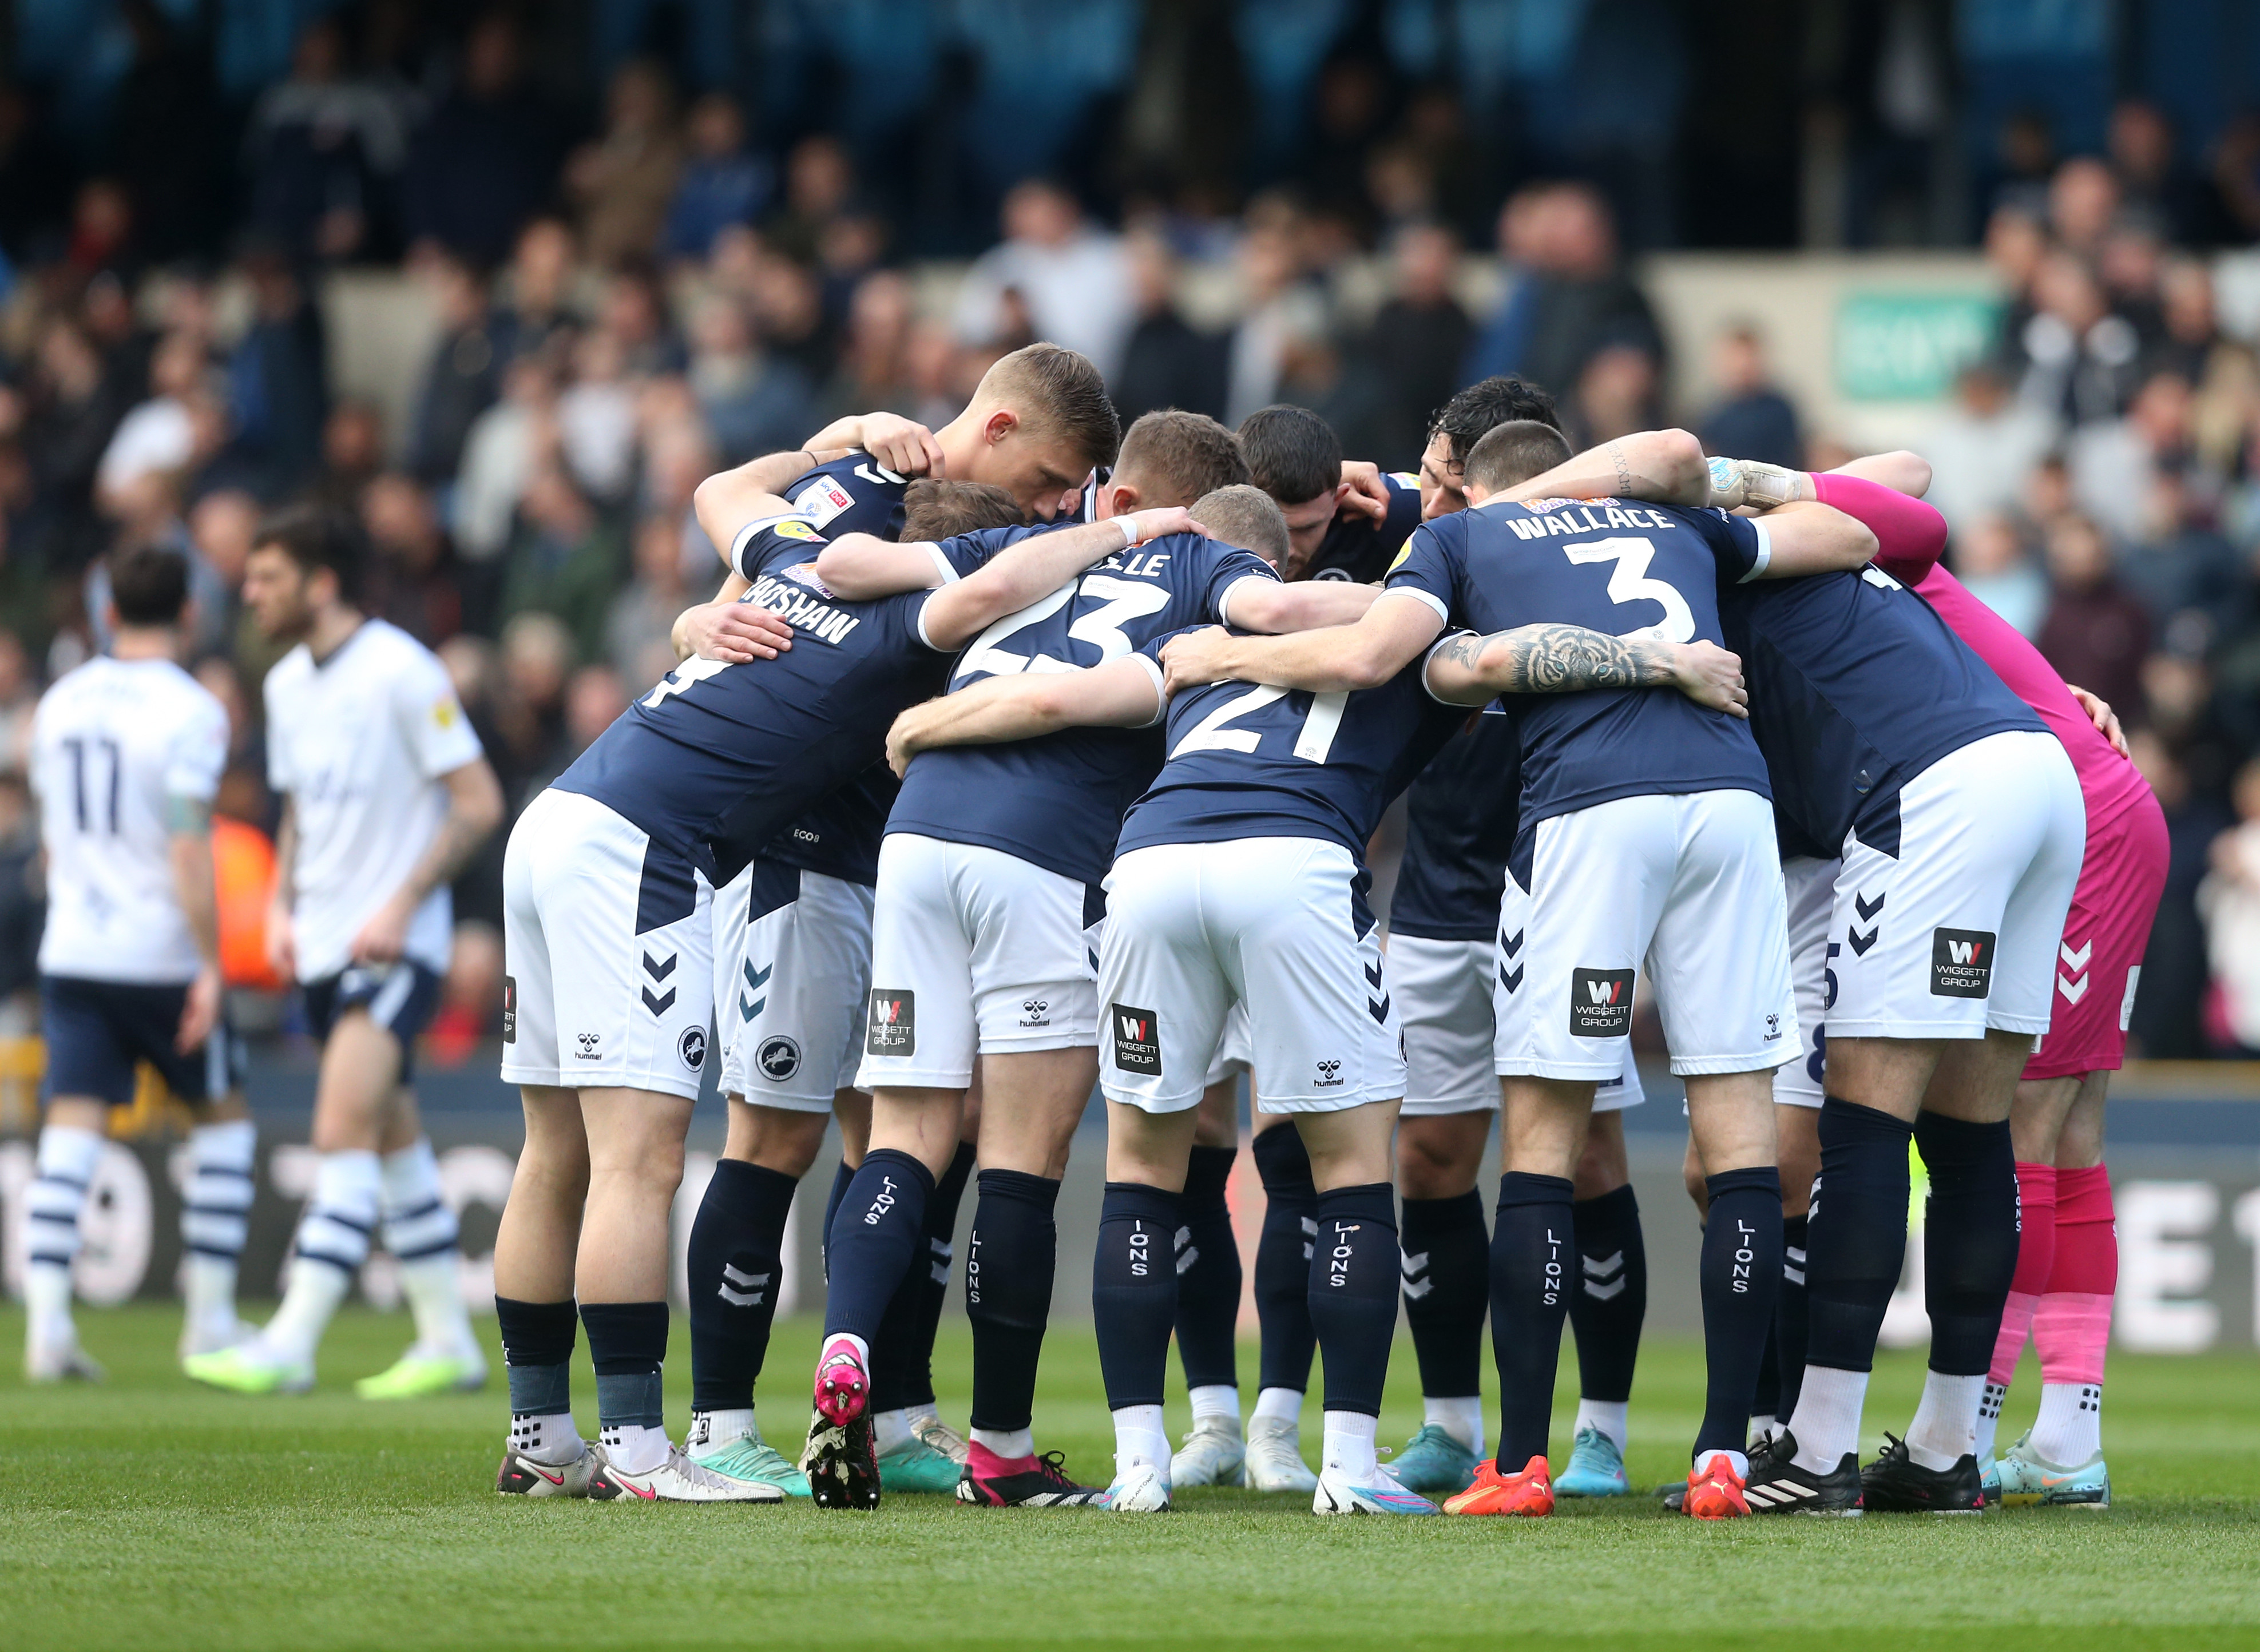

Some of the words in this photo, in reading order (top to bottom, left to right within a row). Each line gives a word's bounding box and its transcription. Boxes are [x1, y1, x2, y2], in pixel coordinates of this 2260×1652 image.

[820, 482, 832, 492] sky
[831, 491, 846, 506] bet
[1505, 507, 1676, 541] WALLACE
[1562, 537, 1696, 643] 3
[954, 574, 1172, 680] 23
[1936, 964, 1988, 978] WIGGETT
[1940, 976, 1981, 988] GROUP
[1575, 1005, 1628, 1016] WIGGETT
[871, 1024, 911, 1035] WIGGETT
[1020, 1019, 1050, 1027] hummel
[1580, 1017, 1623, 1028] GROUP
[873, 1036, 905, 1046] GROUP
[1117, 1039, 1157, 1054] WIGGETT
[574, 1051, 602, 1060] hummel
[1121, 1051, 1154, 1065] GROUP
[1313, 1076, 1344, 1087] hummel
[864, 1176, 898, 1225] LIONS
[2013, 1173, 2022, 1232] LIONS
[1129, 1220, 1148, 1276] IONS
[1330, 1221, 1354, 1287] LIONS
[1732, 1219, 1756, 1293] LIONS
[969, 1230, 982, 1303] LIONS
[1543, 1228, 1561, 1305] LIONS
